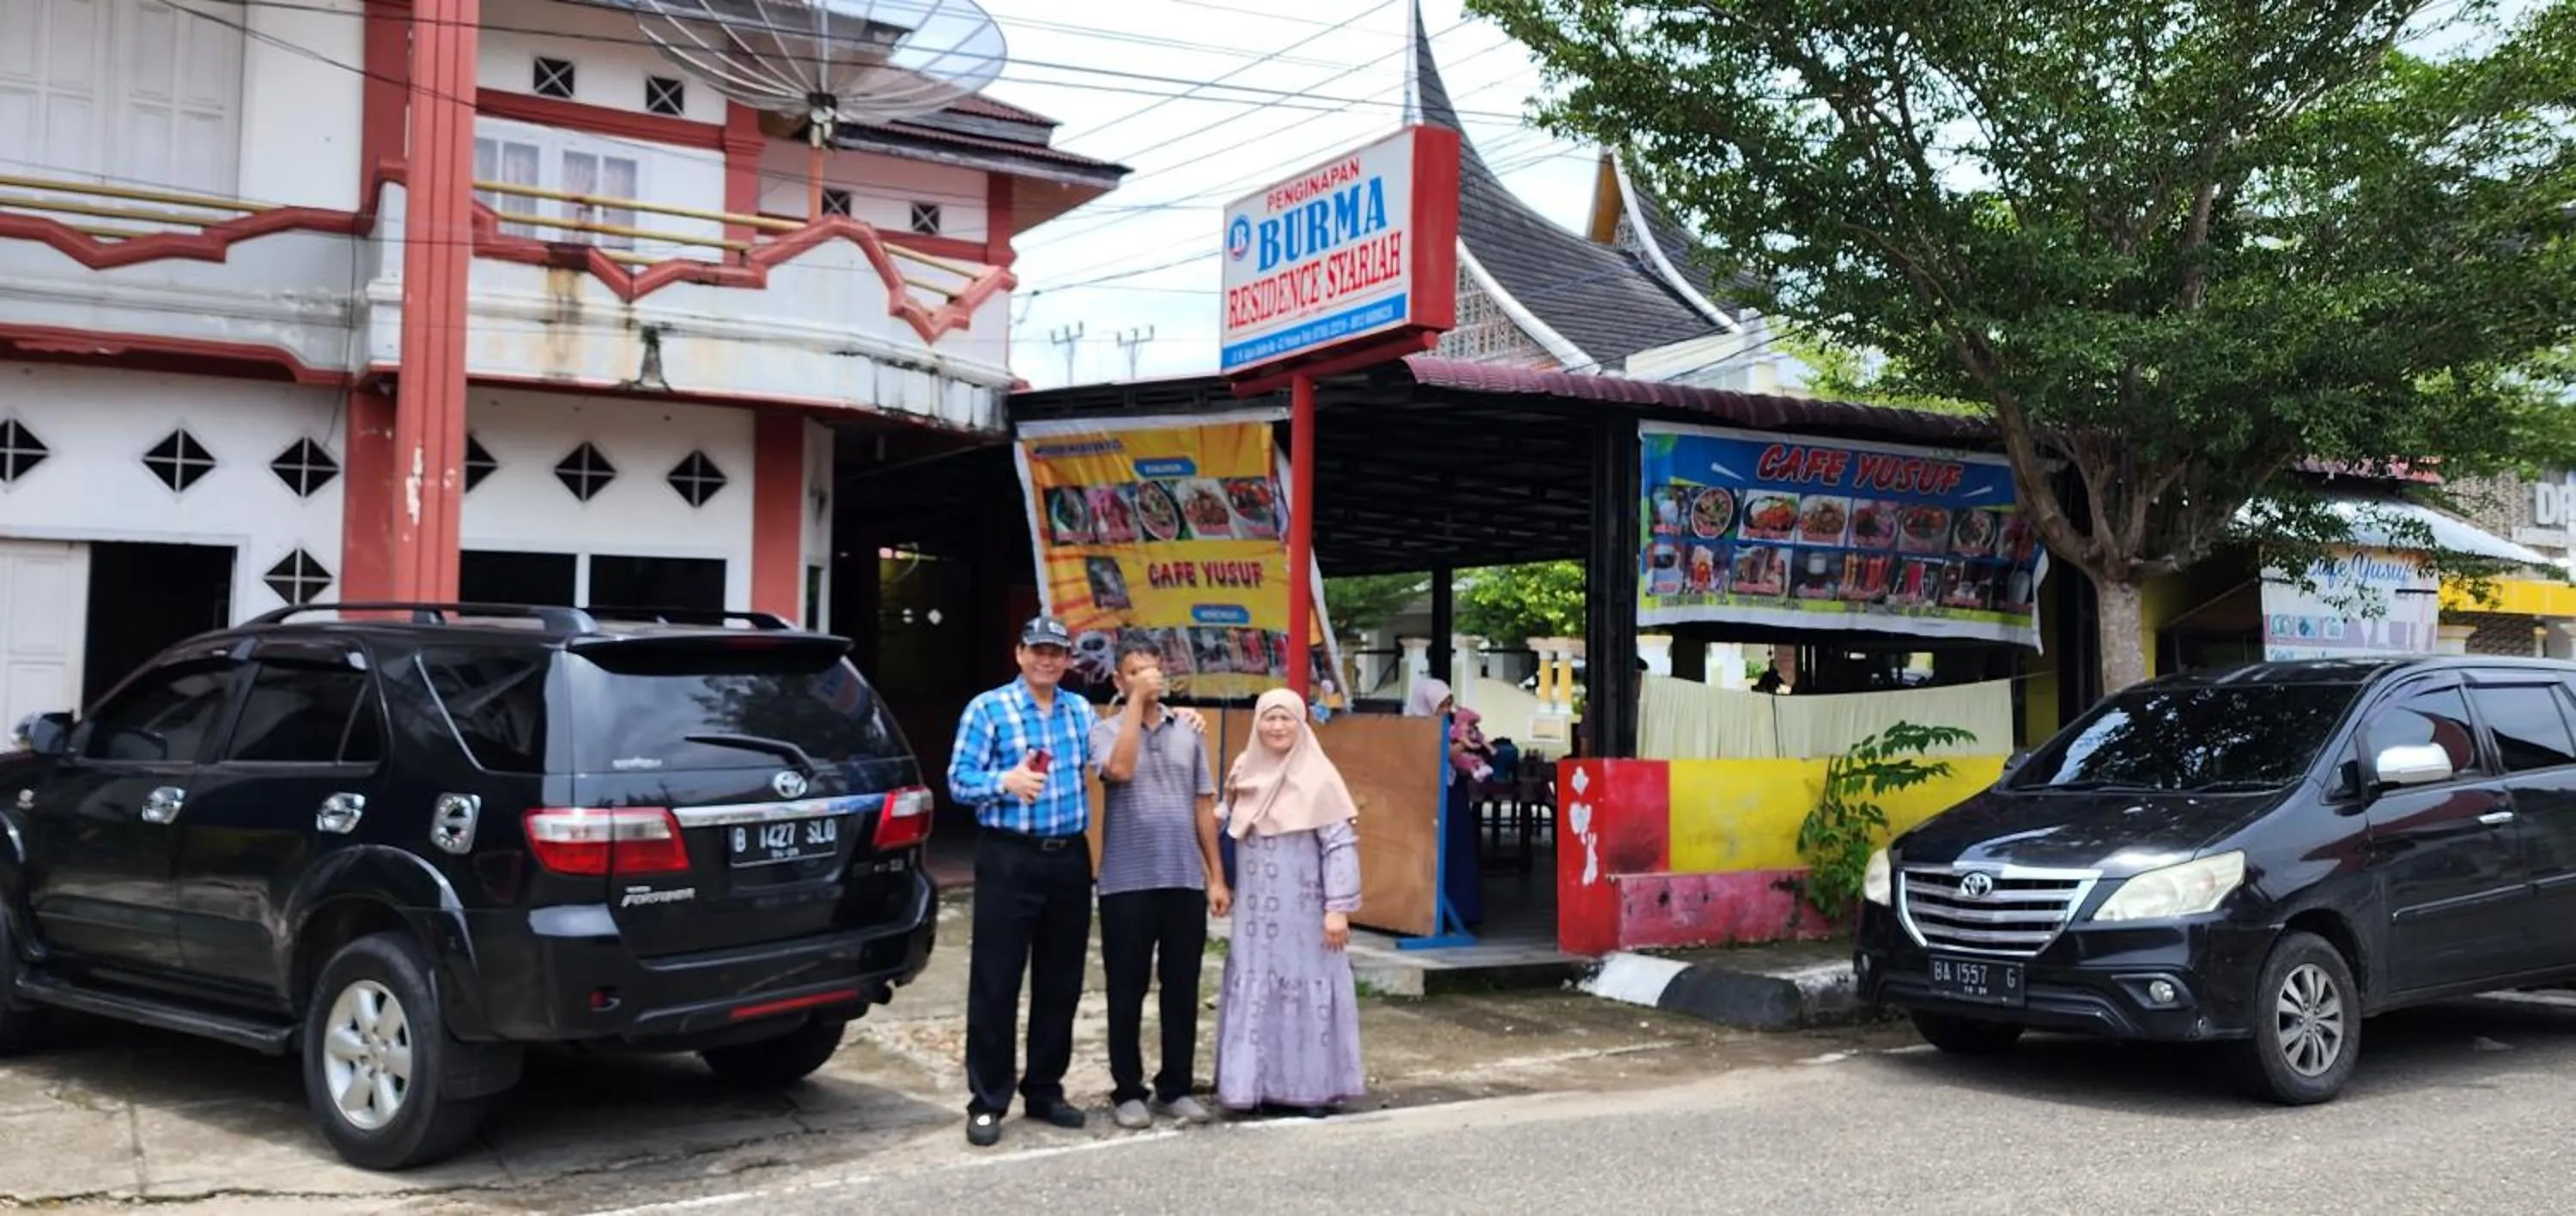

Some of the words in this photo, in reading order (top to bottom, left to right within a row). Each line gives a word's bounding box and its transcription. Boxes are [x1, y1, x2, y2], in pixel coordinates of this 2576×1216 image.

[1267, 157, 1360, 212] PENGINAPAN
[1258, 175, 1387, 272] BURMA
[1228, 261, 1321, 330] RESIDENCE
[1327, 231, 1402, 299] SYARIAH
[1756, 444, 1850, 483] CAFE
[1854, 452, 1965, 496] YUSUF
[1147, 562, 1197, 589] CAFE
[1202, 562, 1264, 589] YUSUF
[734, 827, 746, 853] B
[759, 823, 796, 848] 1427
[1934, 961, 1951, 981] BA
[1955, 962, 1988, 985] 1557
[2006, 967, 2015, 988] G
